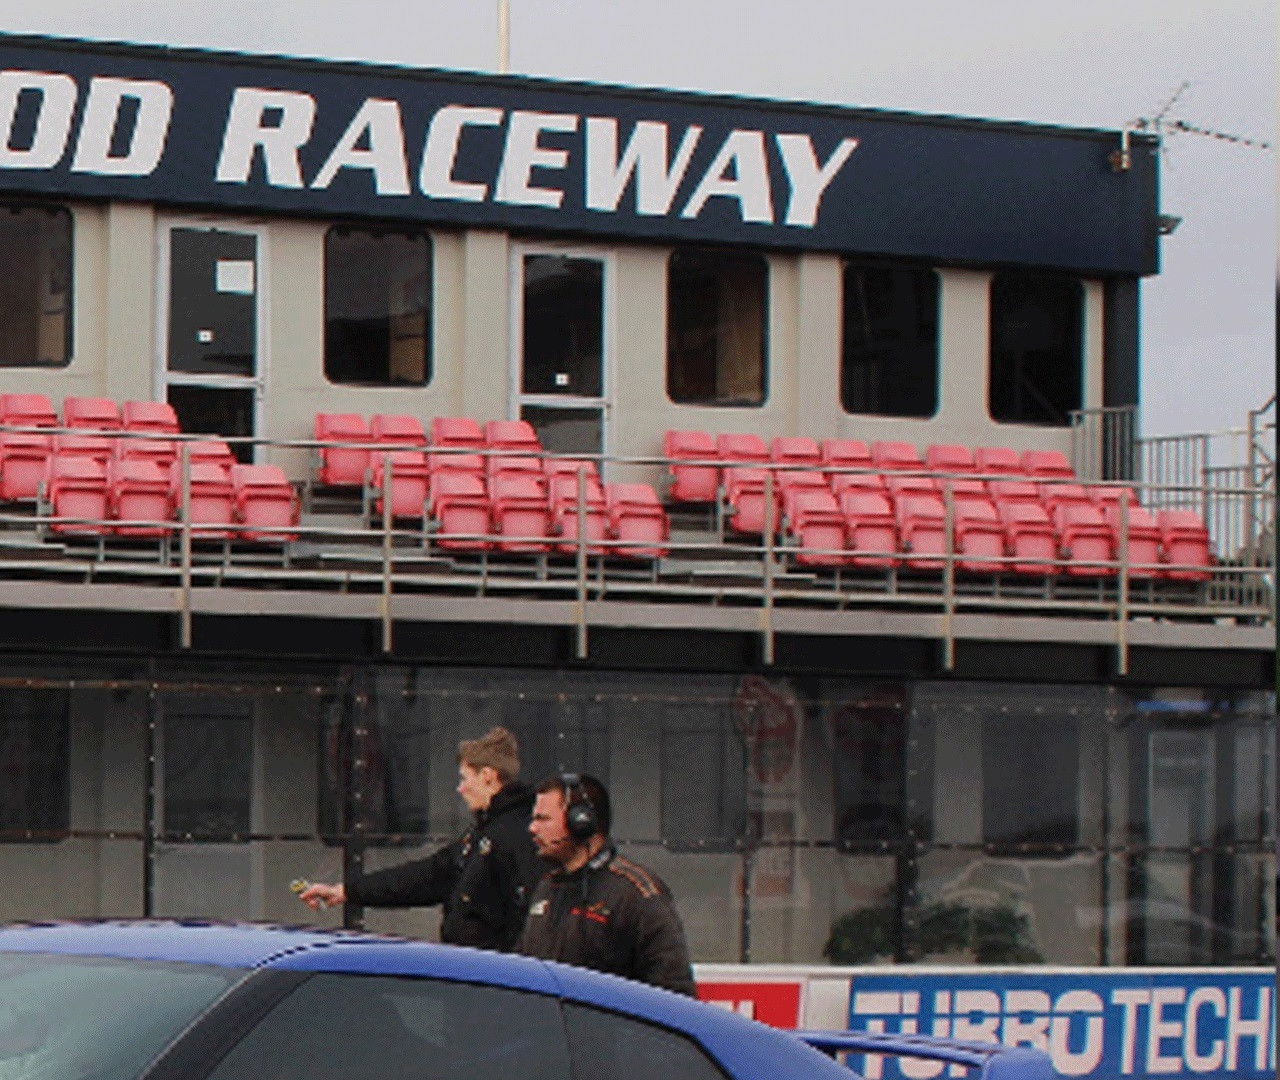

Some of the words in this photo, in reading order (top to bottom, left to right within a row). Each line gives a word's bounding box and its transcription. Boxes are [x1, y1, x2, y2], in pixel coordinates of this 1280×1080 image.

[215, 86, 859, 230] RACEWAY
[851, 988, 1104, 1080] TURBO
[1109, 984, 1276, 1077] TECH
